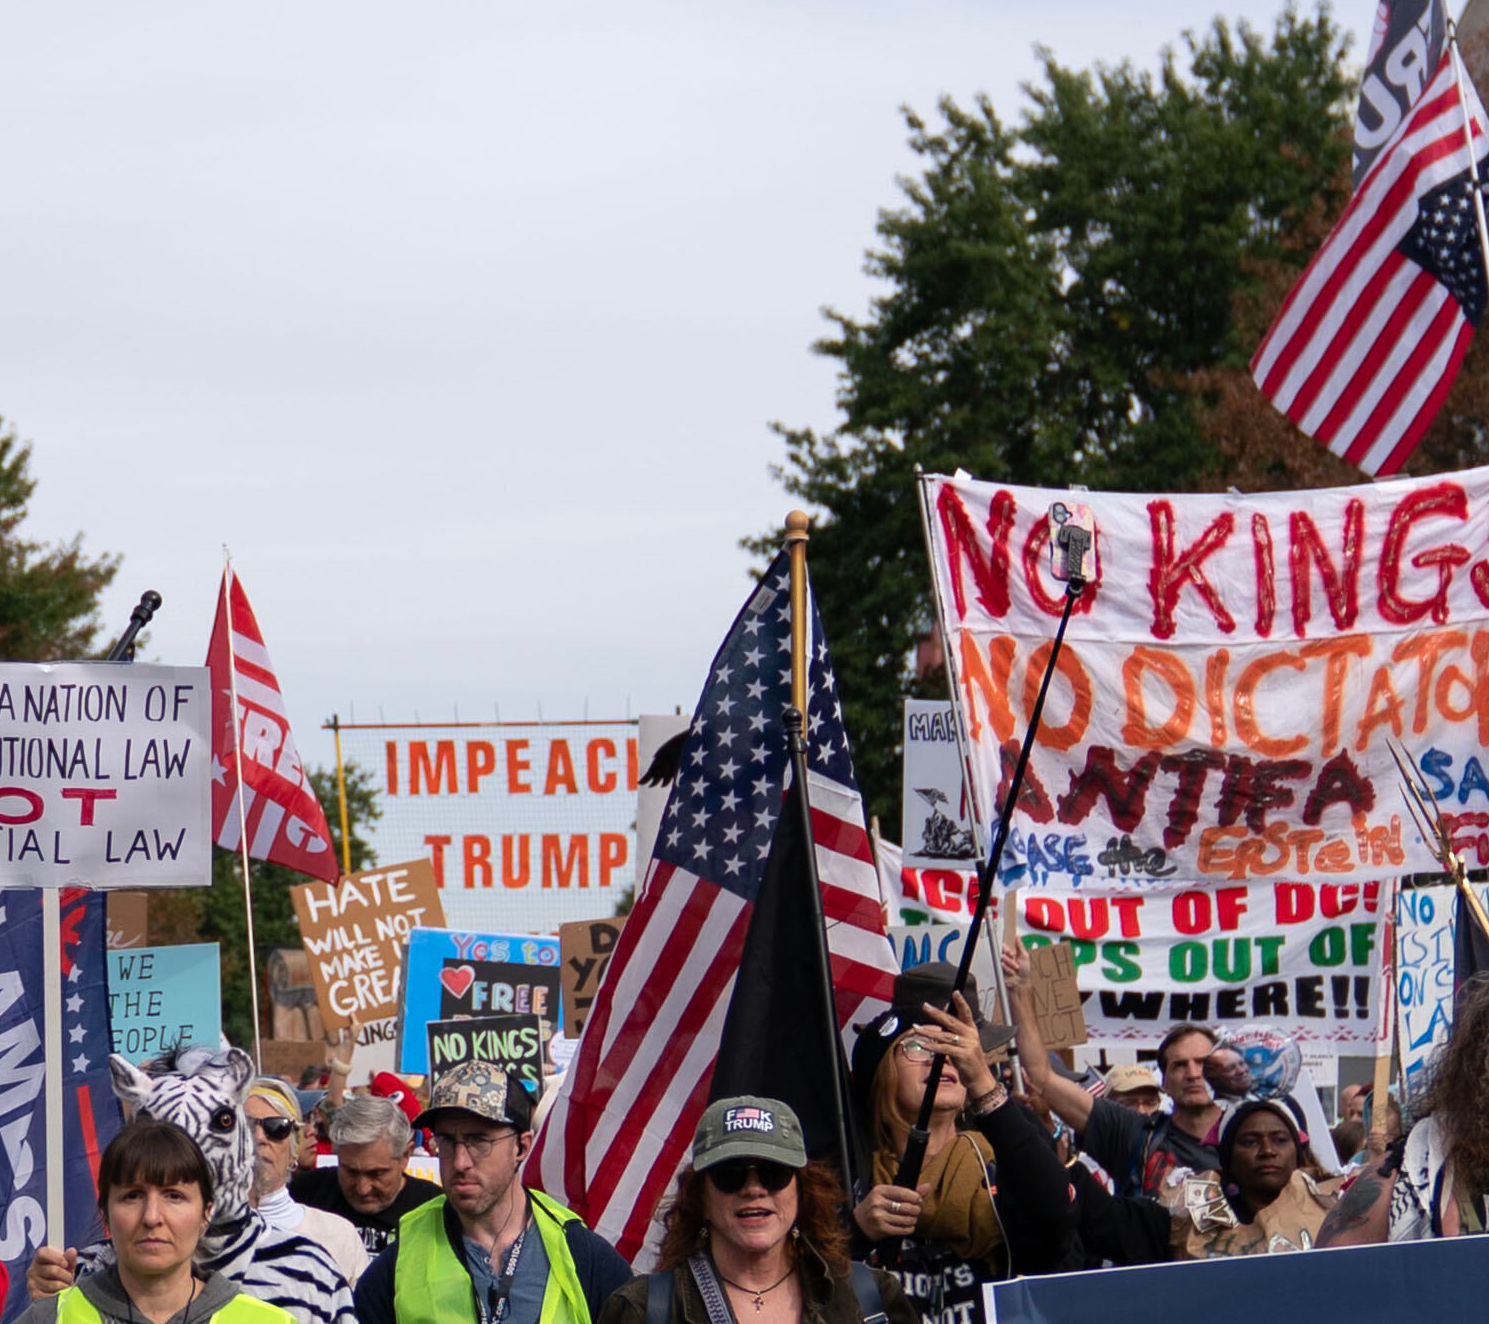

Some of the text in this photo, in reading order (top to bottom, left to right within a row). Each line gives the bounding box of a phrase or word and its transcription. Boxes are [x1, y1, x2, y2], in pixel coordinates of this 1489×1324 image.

[937, 482, 1102, 621] NO
[22, 683, 129, 724] NATION
[145, 685, 194, 722] OF
[959, 628, 1094, 752] NO
[123, 738, 191, 779] LAW
[106, 827, 186, 863] LAW
[424, 834, 629, 889] TRUMP
[1098, 834, 1178, 877] the
[304, 869, 416, 923] HATE
[1024, 894, 1145, 941] OUT
[1172, 886, 1249, 936] OF
[1274, 880, 1381, 926] DC!
[1396, 891, 1435, 927] NO
[303, 923, 372, 956] WILL
[375, 907, 426, 940] NOT
[118, 953, 155, 981] WE
[320, 945, 383, 983] MAKE
[523, 943, 557, 964] to
[1168, 935, 1286, 983] OUT
[1308, 922, 1378, 968] OF
[472, 980, 550, 1016] FREE
[111, 1025, 194, 1055] EOPLE
[433, 1033, 467, 1064] NO
[472, 1027, 539, 1062] KINGS
[724, 1118, 774, 1132] TRUMP
